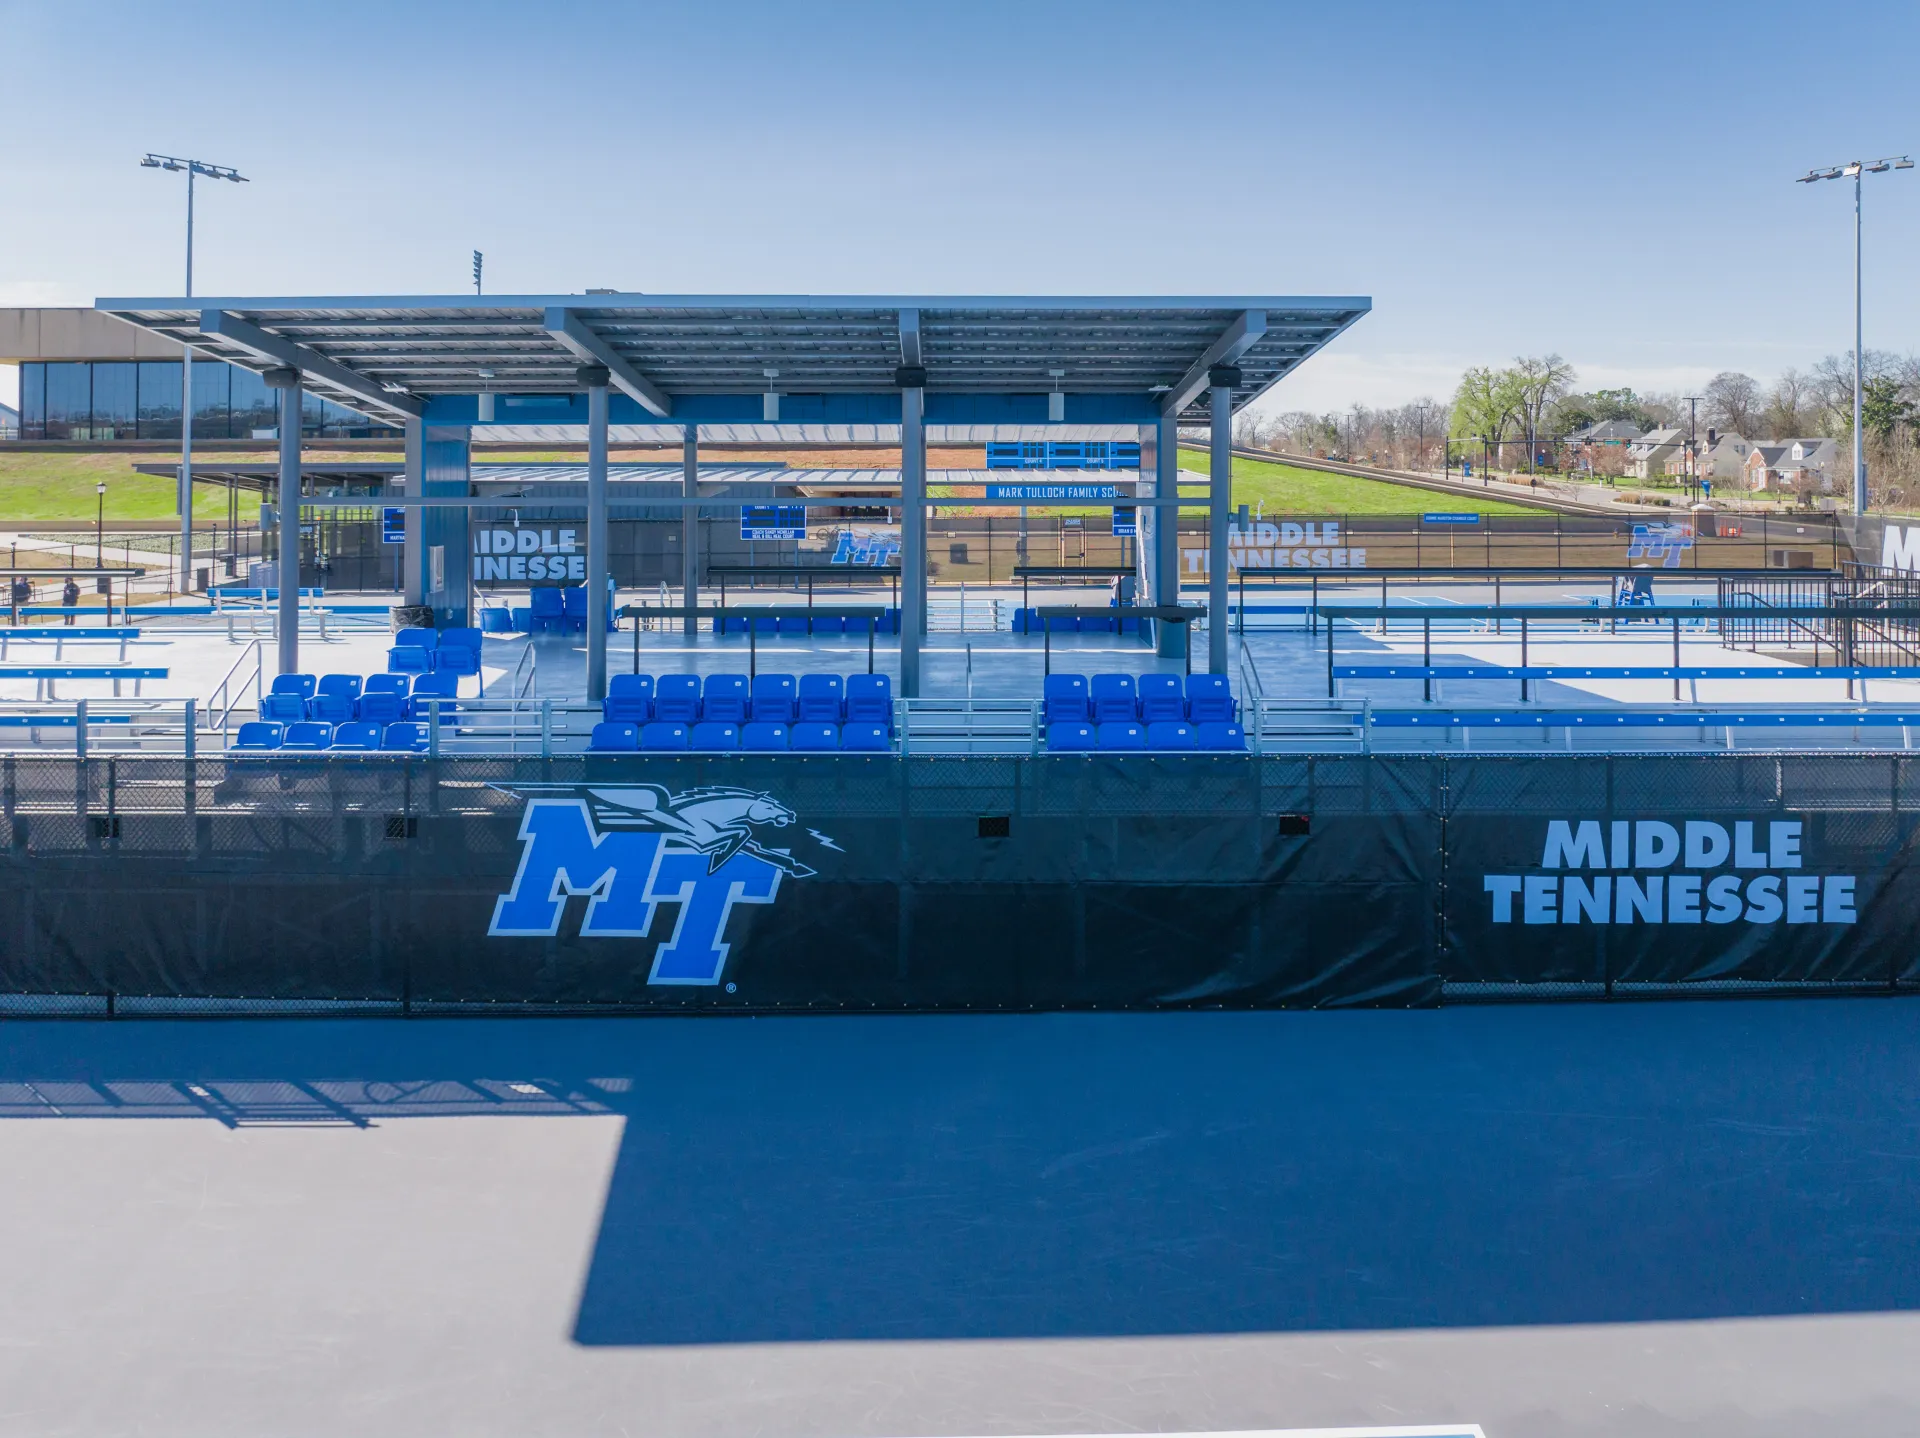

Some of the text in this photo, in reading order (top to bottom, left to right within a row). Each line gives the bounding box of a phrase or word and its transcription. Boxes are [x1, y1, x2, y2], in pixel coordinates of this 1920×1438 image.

[998, 487, 1023, 498] MARK
[1026, 487, 1065, 498] TULLOCH
[1068, 487, 1098, 498] FAMILY
[831, 530, 901, 567] MT
[1627, 525, 1693, 568] MT
[1541, 820, 1802, 868] MIDDLE
[487, 798, 783, 985] MT
[1484, 875, 1857, 924] TENNESSEE
